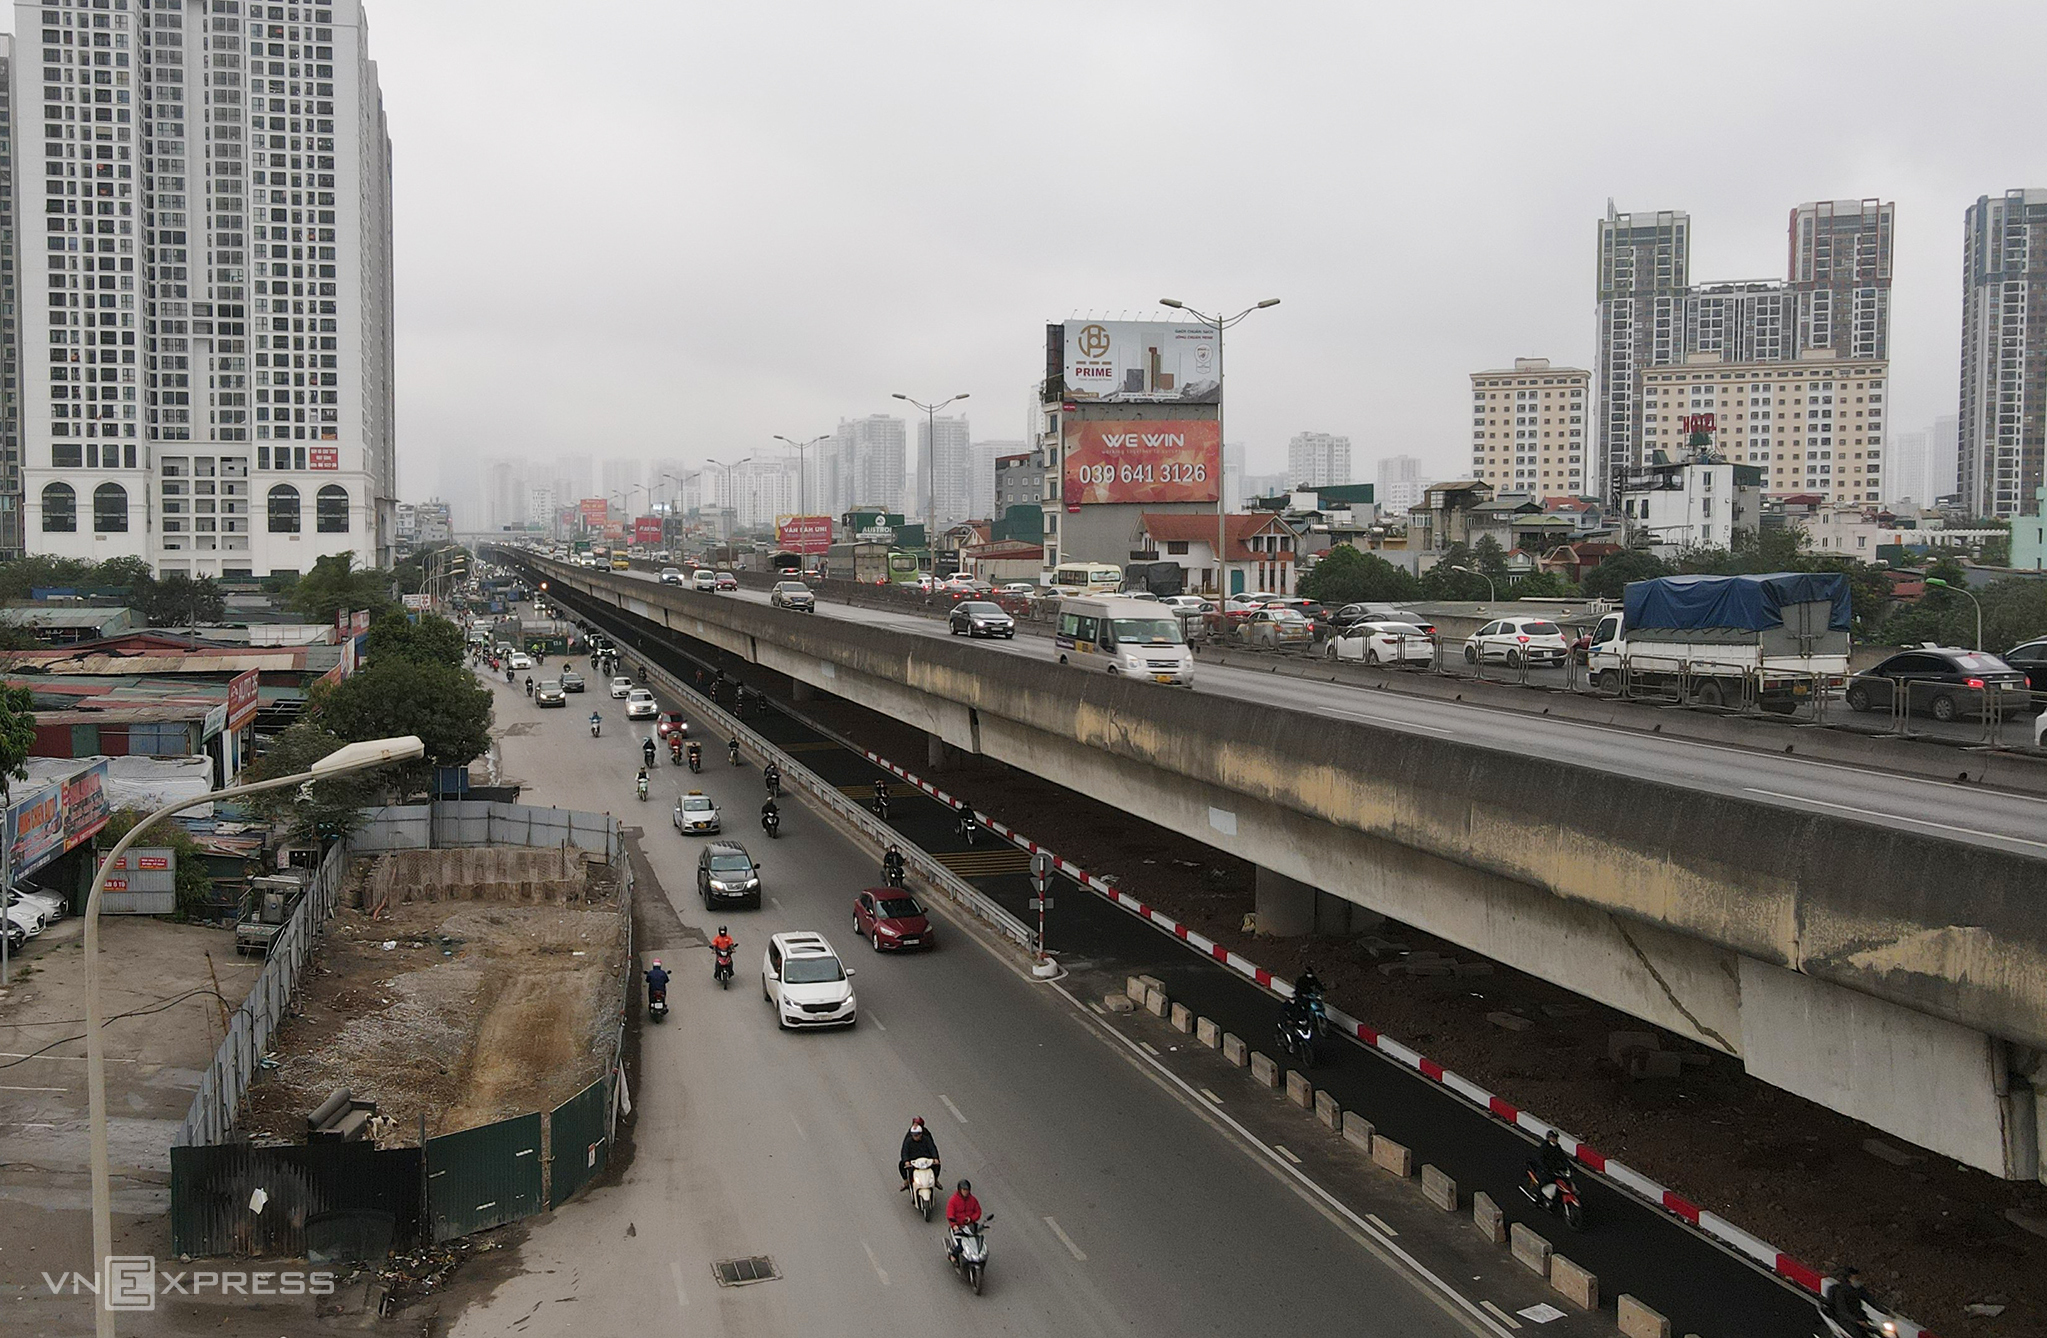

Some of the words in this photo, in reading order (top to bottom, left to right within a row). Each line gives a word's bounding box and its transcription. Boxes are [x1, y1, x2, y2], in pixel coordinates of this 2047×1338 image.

[1075, 367, 1112, 377] PRIME
[1683, 412, 1716, 433] HOTEL
[1101, 433, 1138, 448] WE
[1141, 433, 1184, 448] WIN
[1080, 464, 1115, 484] 039
[1121, 464, 1155, 483] 641
[1160, 463, 1206, 483] 3126
